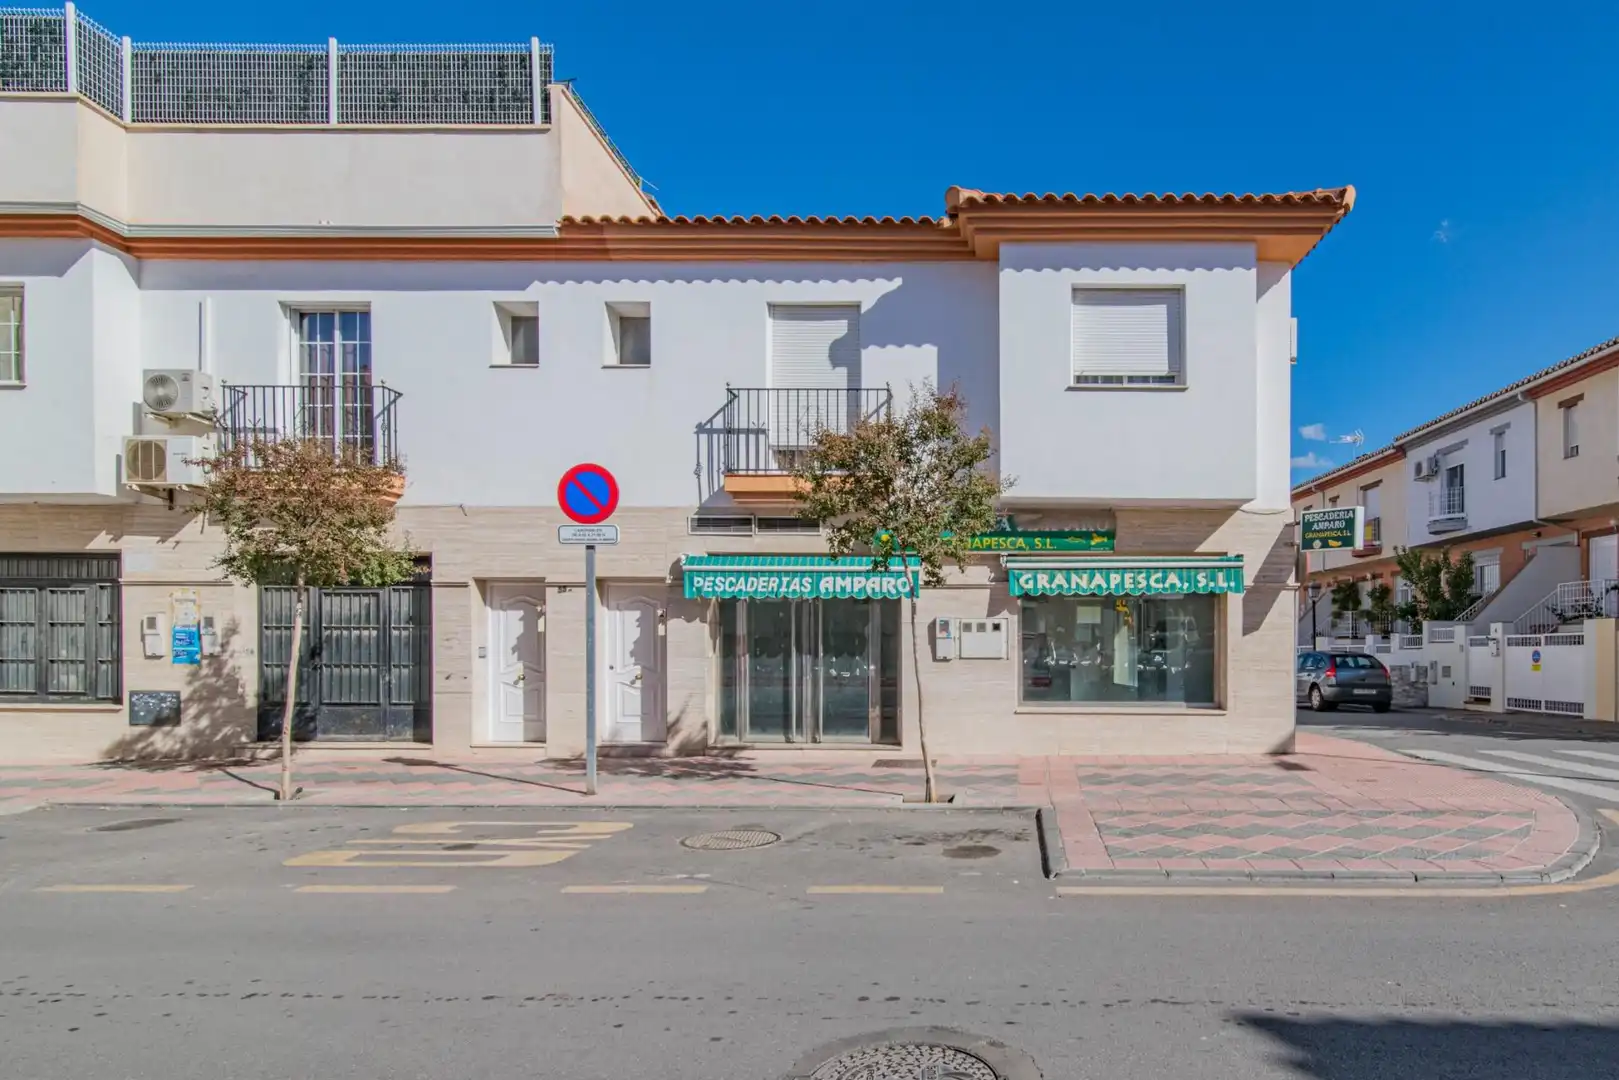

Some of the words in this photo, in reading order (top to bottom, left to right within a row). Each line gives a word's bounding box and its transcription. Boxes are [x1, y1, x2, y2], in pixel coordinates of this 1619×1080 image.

[1304, 511, 1354, 522] PESCADERIA
[1312, 520, 1346, 530] AMPARO
[1034, 537, 1057, 549] S.L.
[692, 576, 812, 593] PESCADERIAS
[819, 576, 912, 594] AMPARO
[1018, 572, 1189, 590] GRANAPESCA,
[1196, 572, 1236, 588] S.L.
